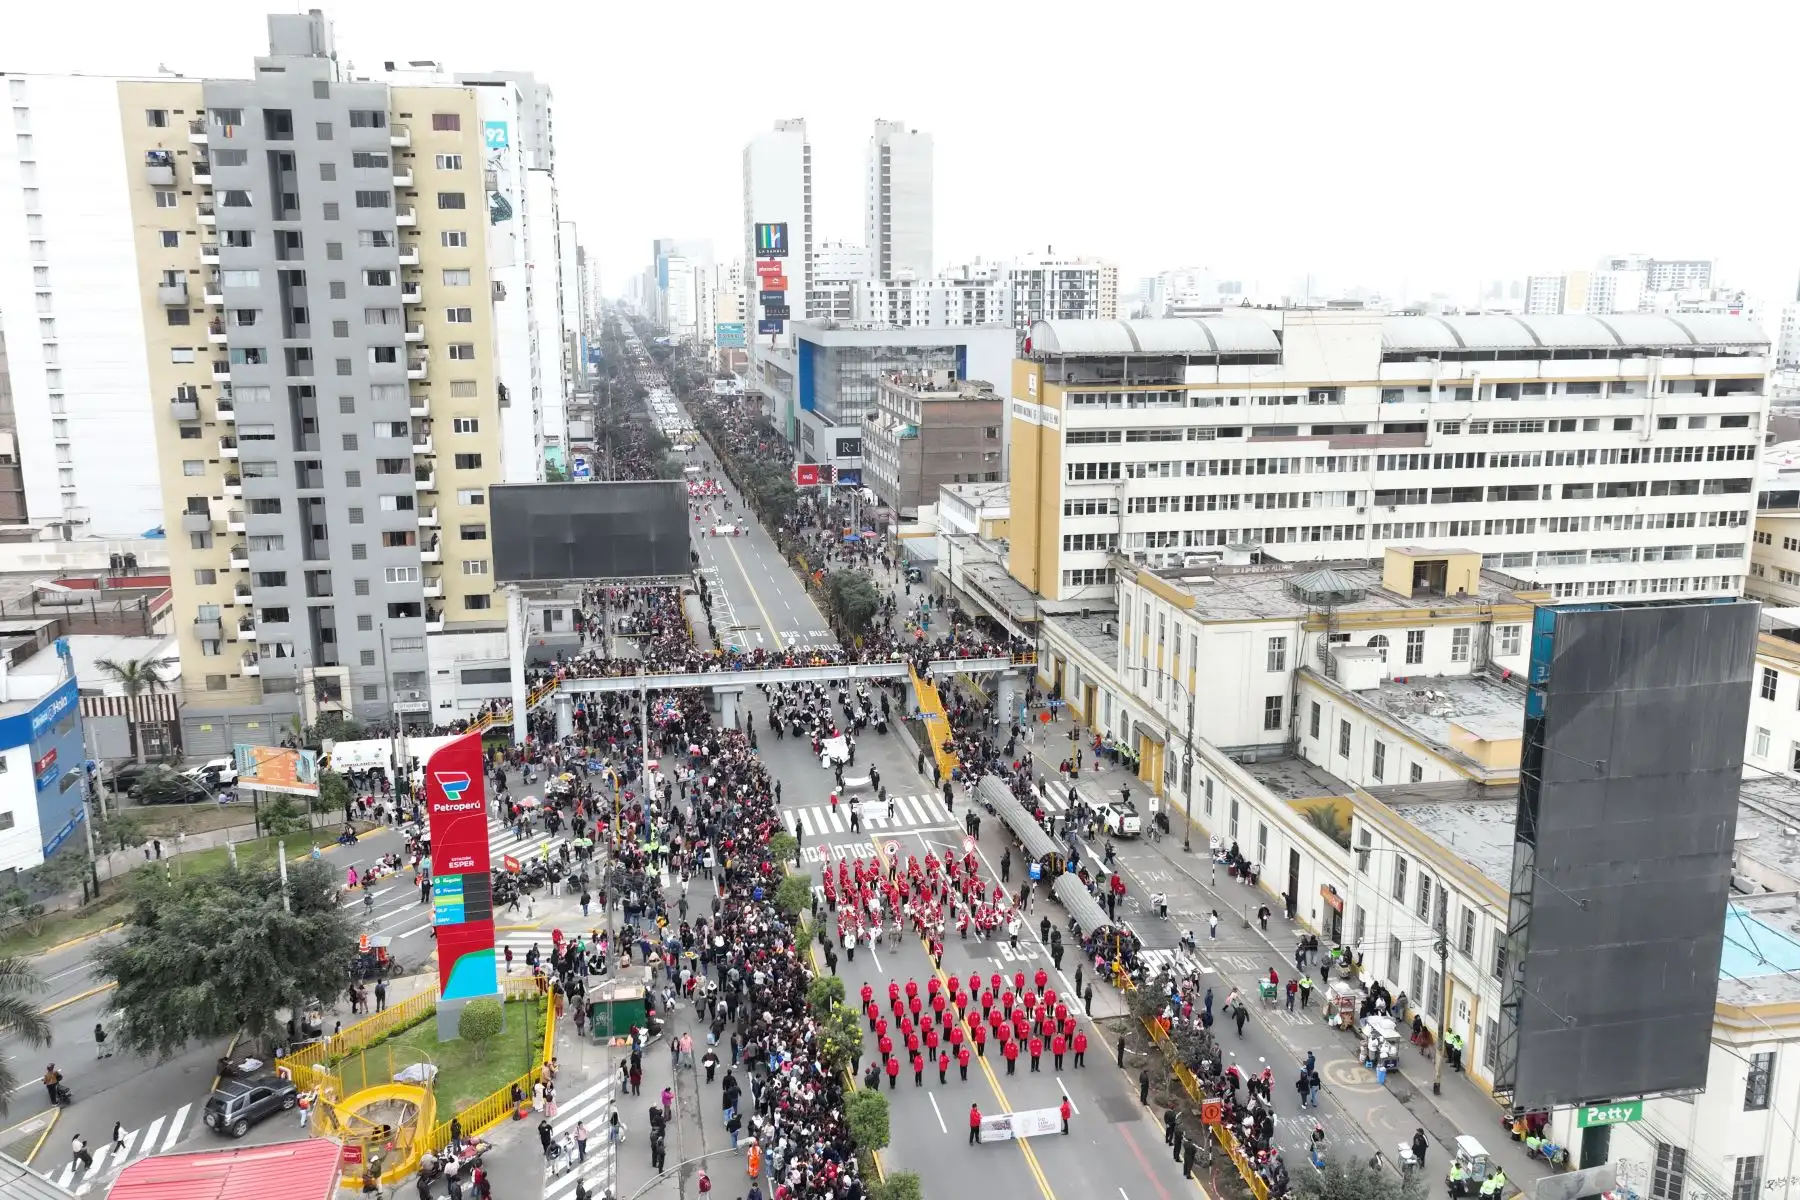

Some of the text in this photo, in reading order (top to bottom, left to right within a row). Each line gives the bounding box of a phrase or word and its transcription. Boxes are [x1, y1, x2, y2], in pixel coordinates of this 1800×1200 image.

[486, 128, 505, 142] 92
[434, 800, 480, 812] Petroperú
[448, 860, 475, 869] ESPER
[1587, 1106, 1633, 1121] Petty
